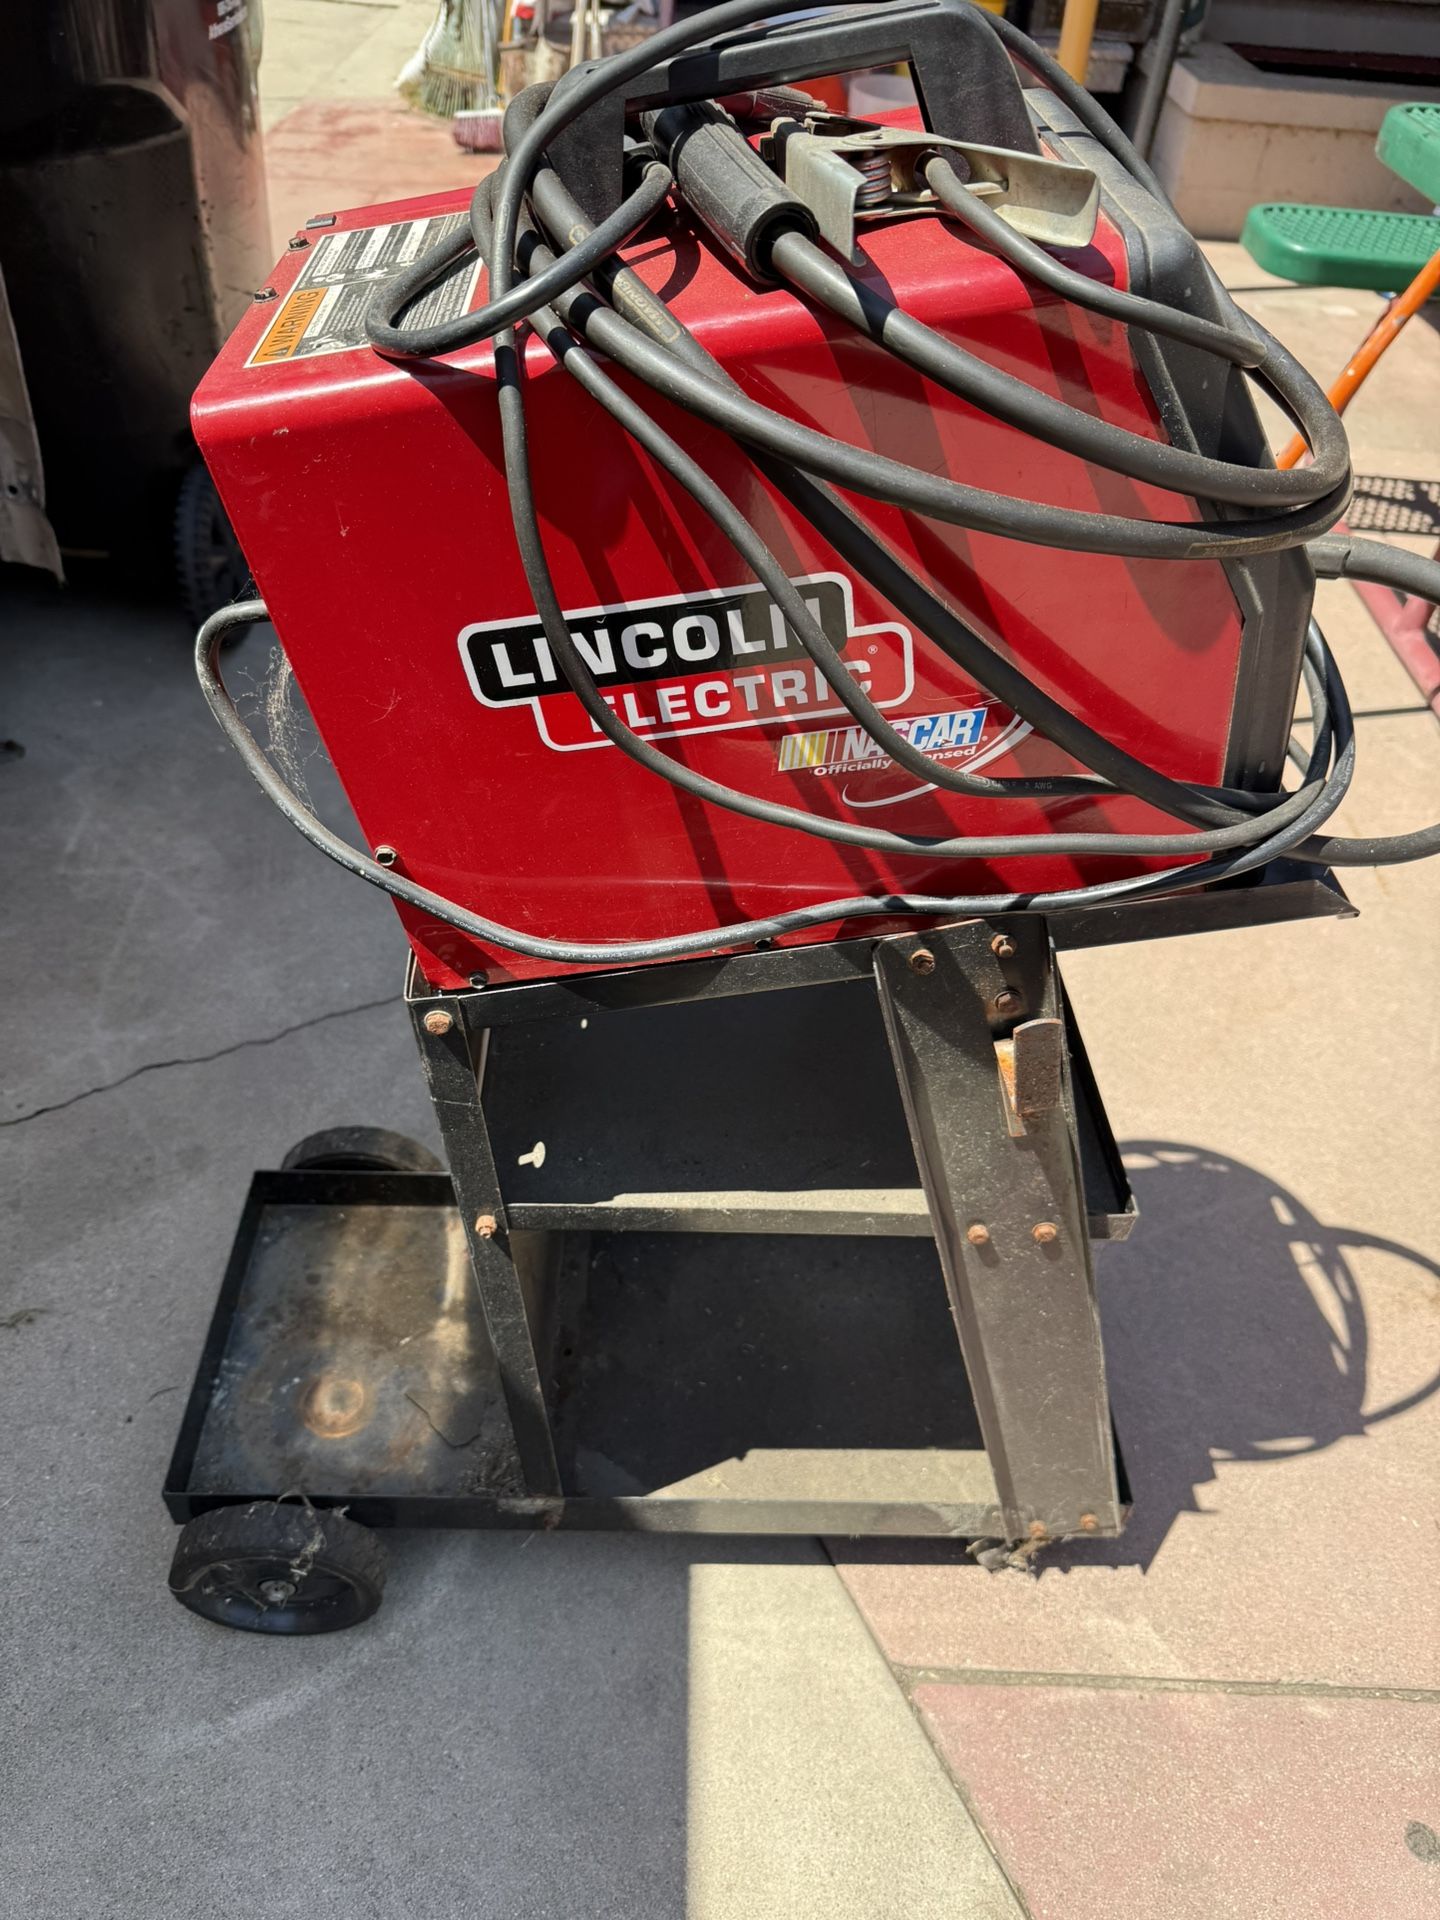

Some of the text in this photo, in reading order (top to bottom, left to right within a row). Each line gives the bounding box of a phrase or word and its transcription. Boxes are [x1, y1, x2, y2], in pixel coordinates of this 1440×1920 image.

[268, 291, 320, 347] WARNING
[590, 660, 872, 733] LECTRIC
[813, 758, 893, 777] Officially
[1033, 781, 1053, 790] AWG
